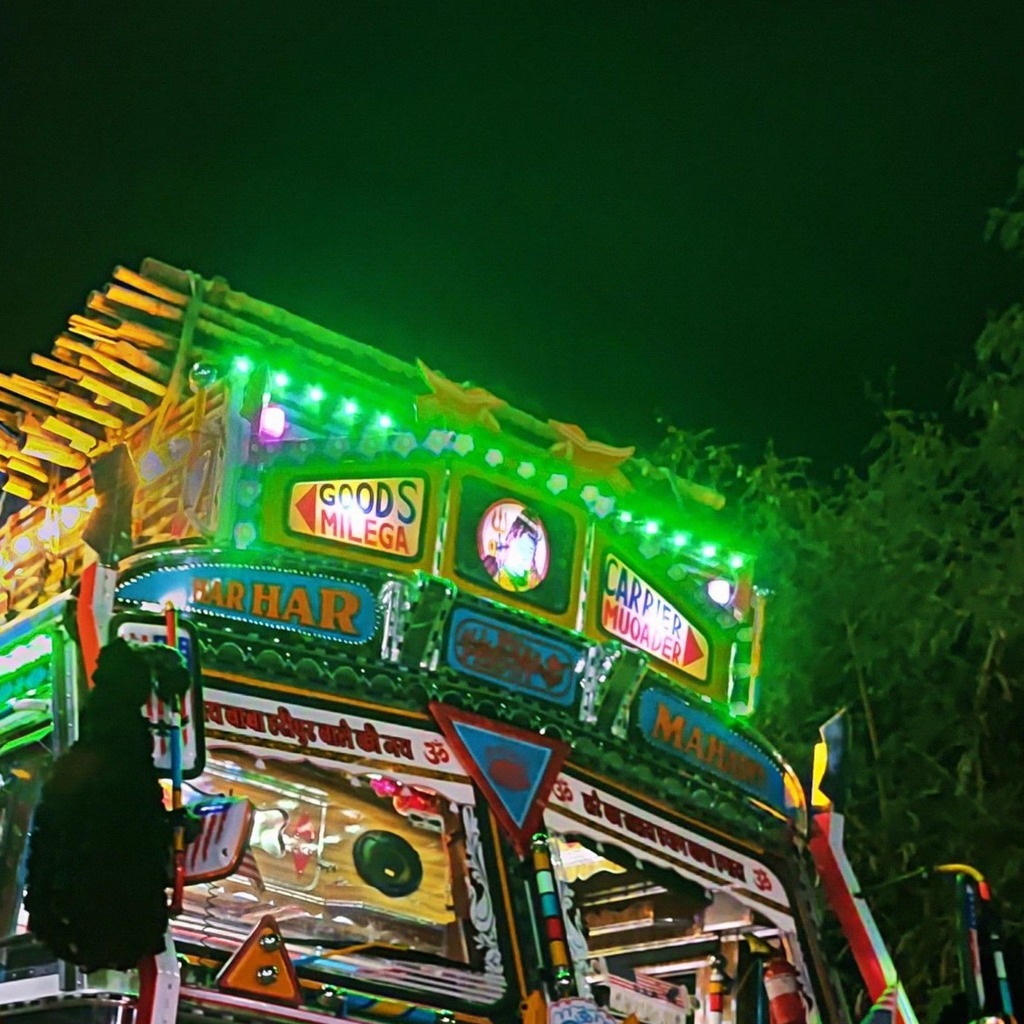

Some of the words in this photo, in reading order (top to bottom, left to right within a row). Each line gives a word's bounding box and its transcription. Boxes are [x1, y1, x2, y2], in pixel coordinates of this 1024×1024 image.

[319, 480, 418, 525] GOODS
[320, 509, 411, 555] MILEGA
[250, 583, 362, 636] HAR
